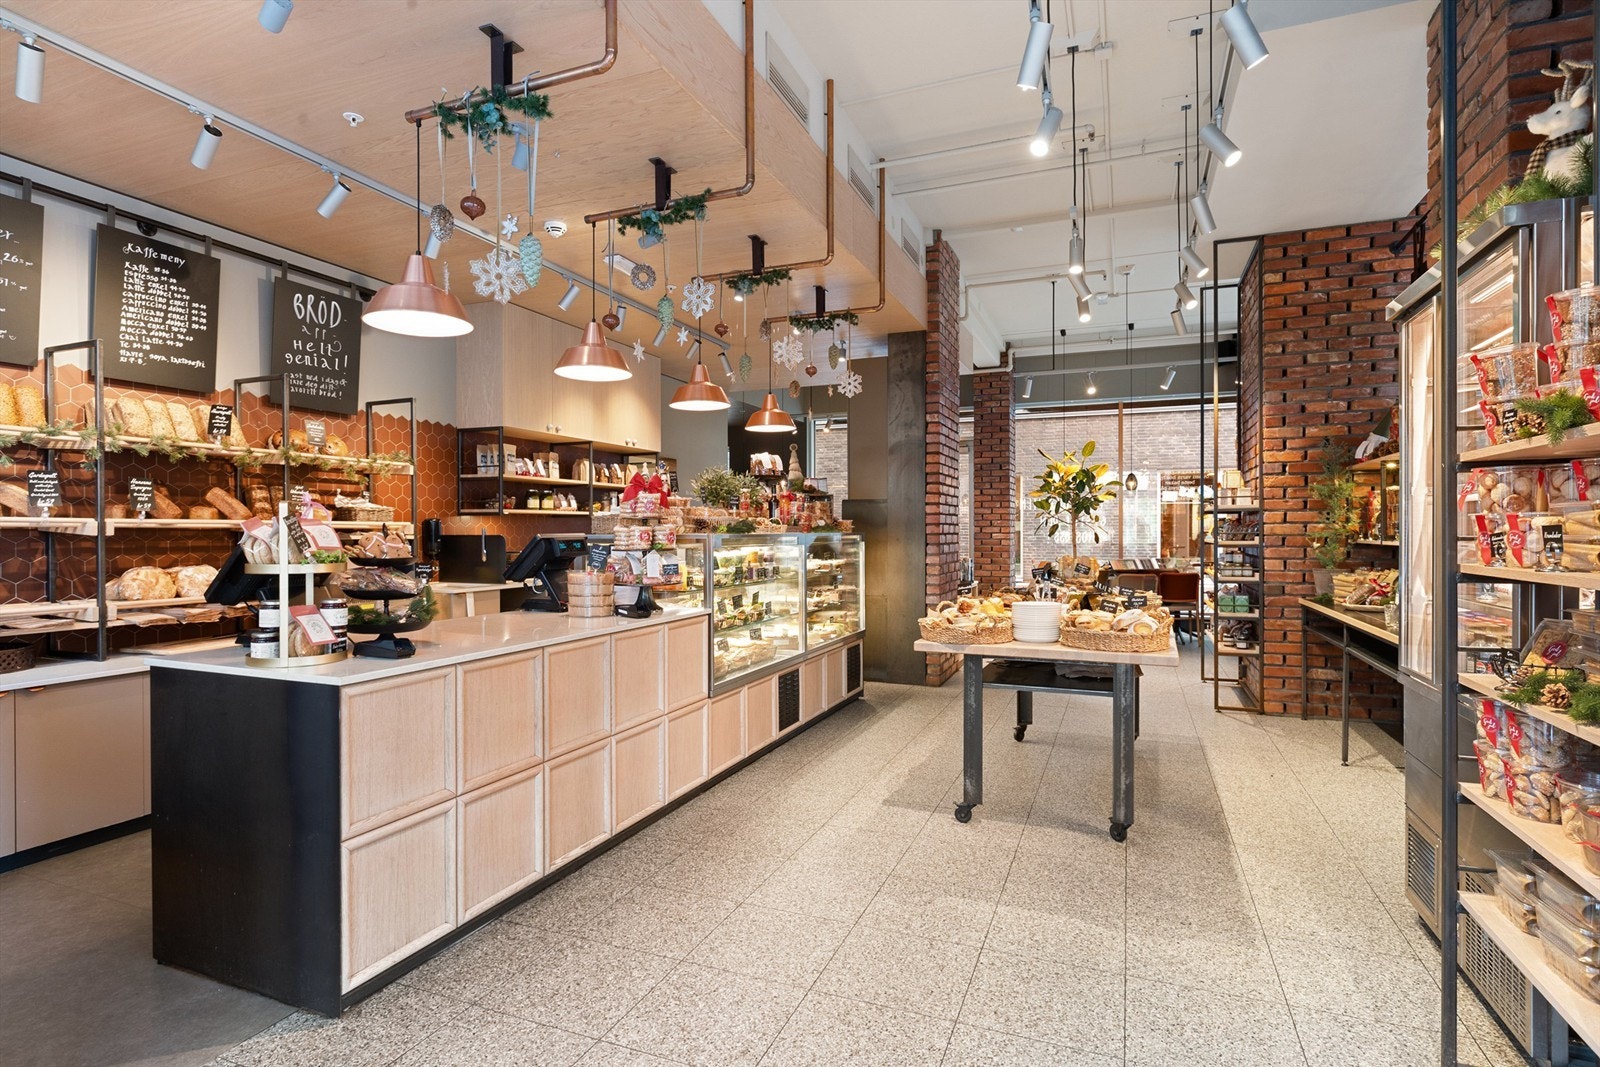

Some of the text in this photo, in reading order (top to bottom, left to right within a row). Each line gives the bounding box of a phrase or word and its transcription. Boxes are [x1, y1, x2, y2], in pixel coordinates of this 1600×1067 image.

[123, 242, 159, 259] Kaffe
[124, 261, 149, 274] Kaffe
[124, 270, 159, 282] Espresso
[121, 304, 164, 317] Americano
[120, 311, 163, 323] Americano
[120, 318, 145, 327] Mocca
[120, 325, 148, 335] Mocca
[119, 333, 139, 341] Chai
[142, 335, 164, 345] Latte
[293, 339, 342, 356] Helt
